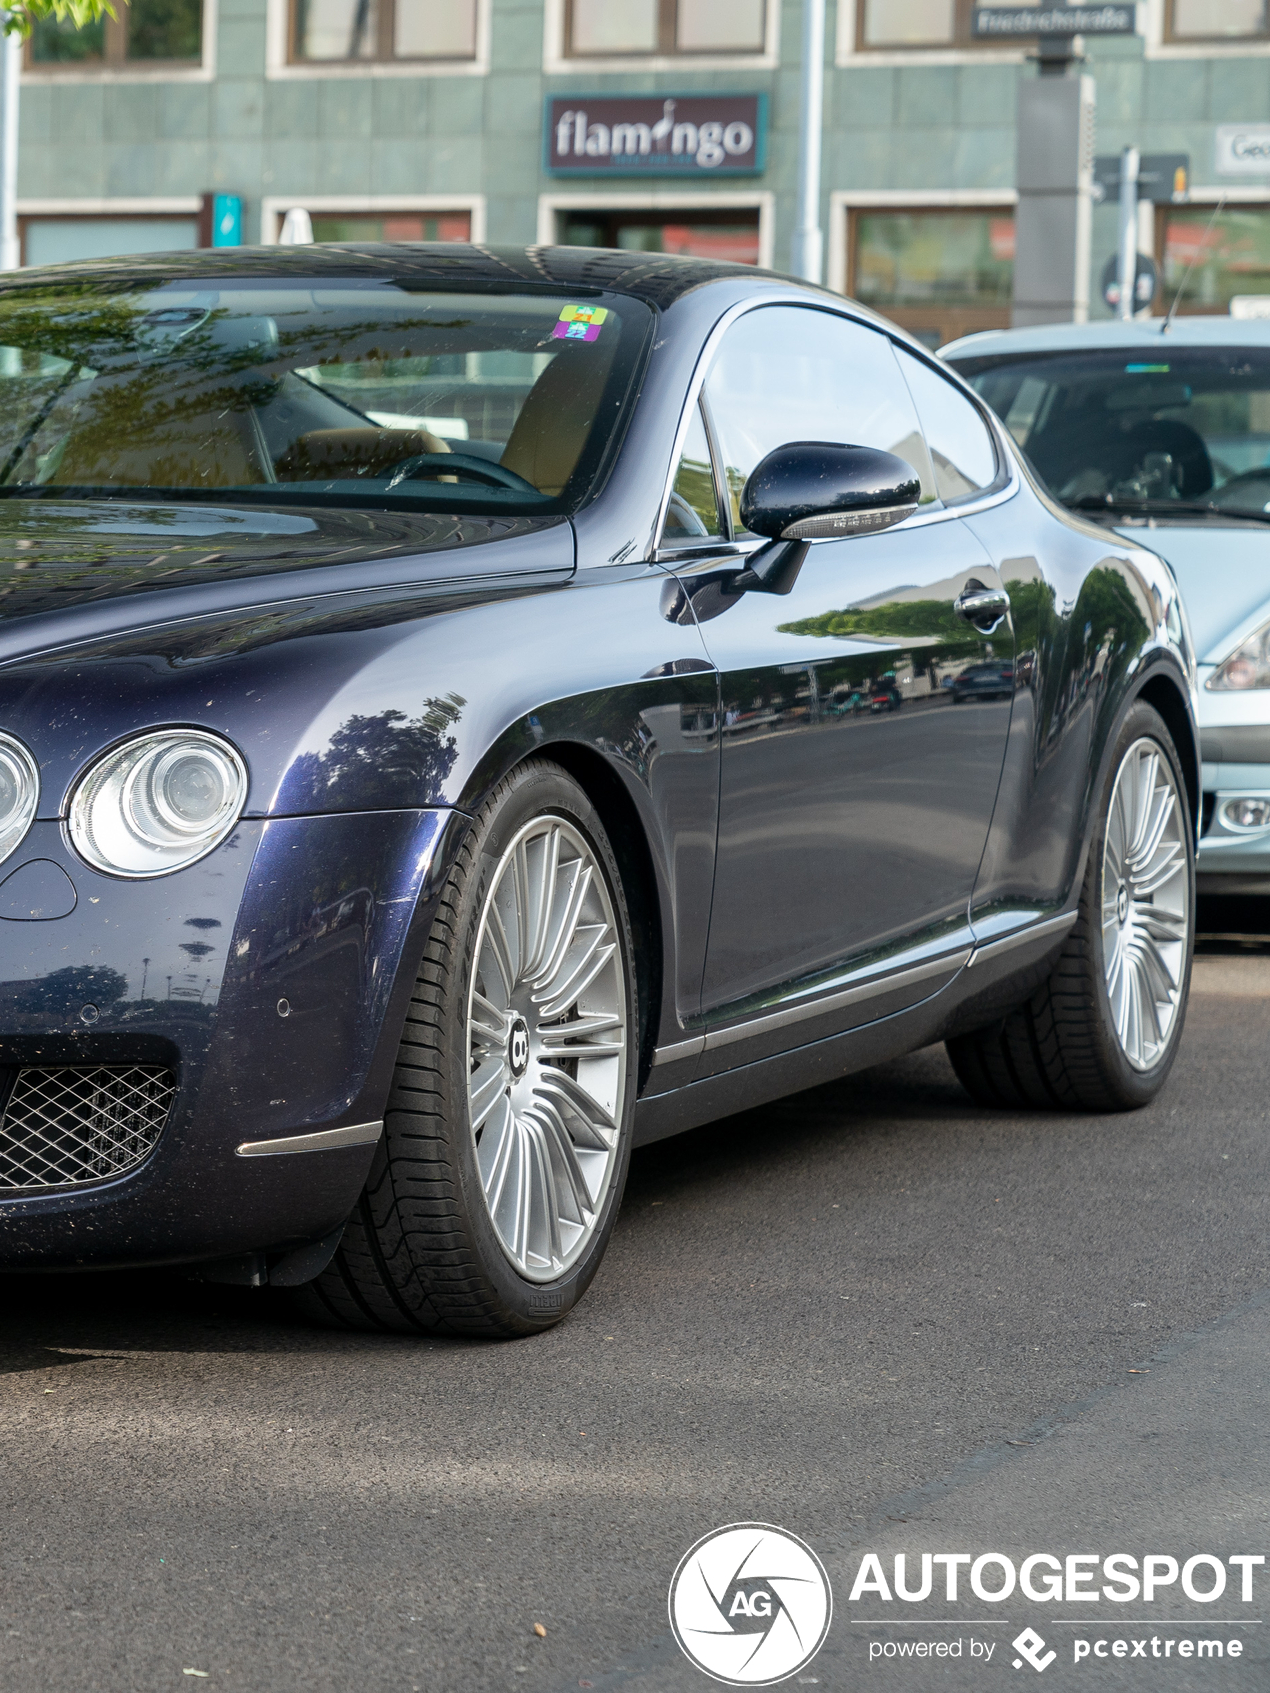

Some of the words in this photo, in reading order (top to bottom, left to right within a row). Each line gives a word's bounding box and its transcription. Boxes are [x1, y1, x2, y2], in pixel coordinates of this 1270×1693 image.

[978, 6, 1129, 32] Friedrichstraße
[556, 99, 754, 168] flamingo
[572, 313, 593, 322] 21
[564, 328, 587, 339] 22
